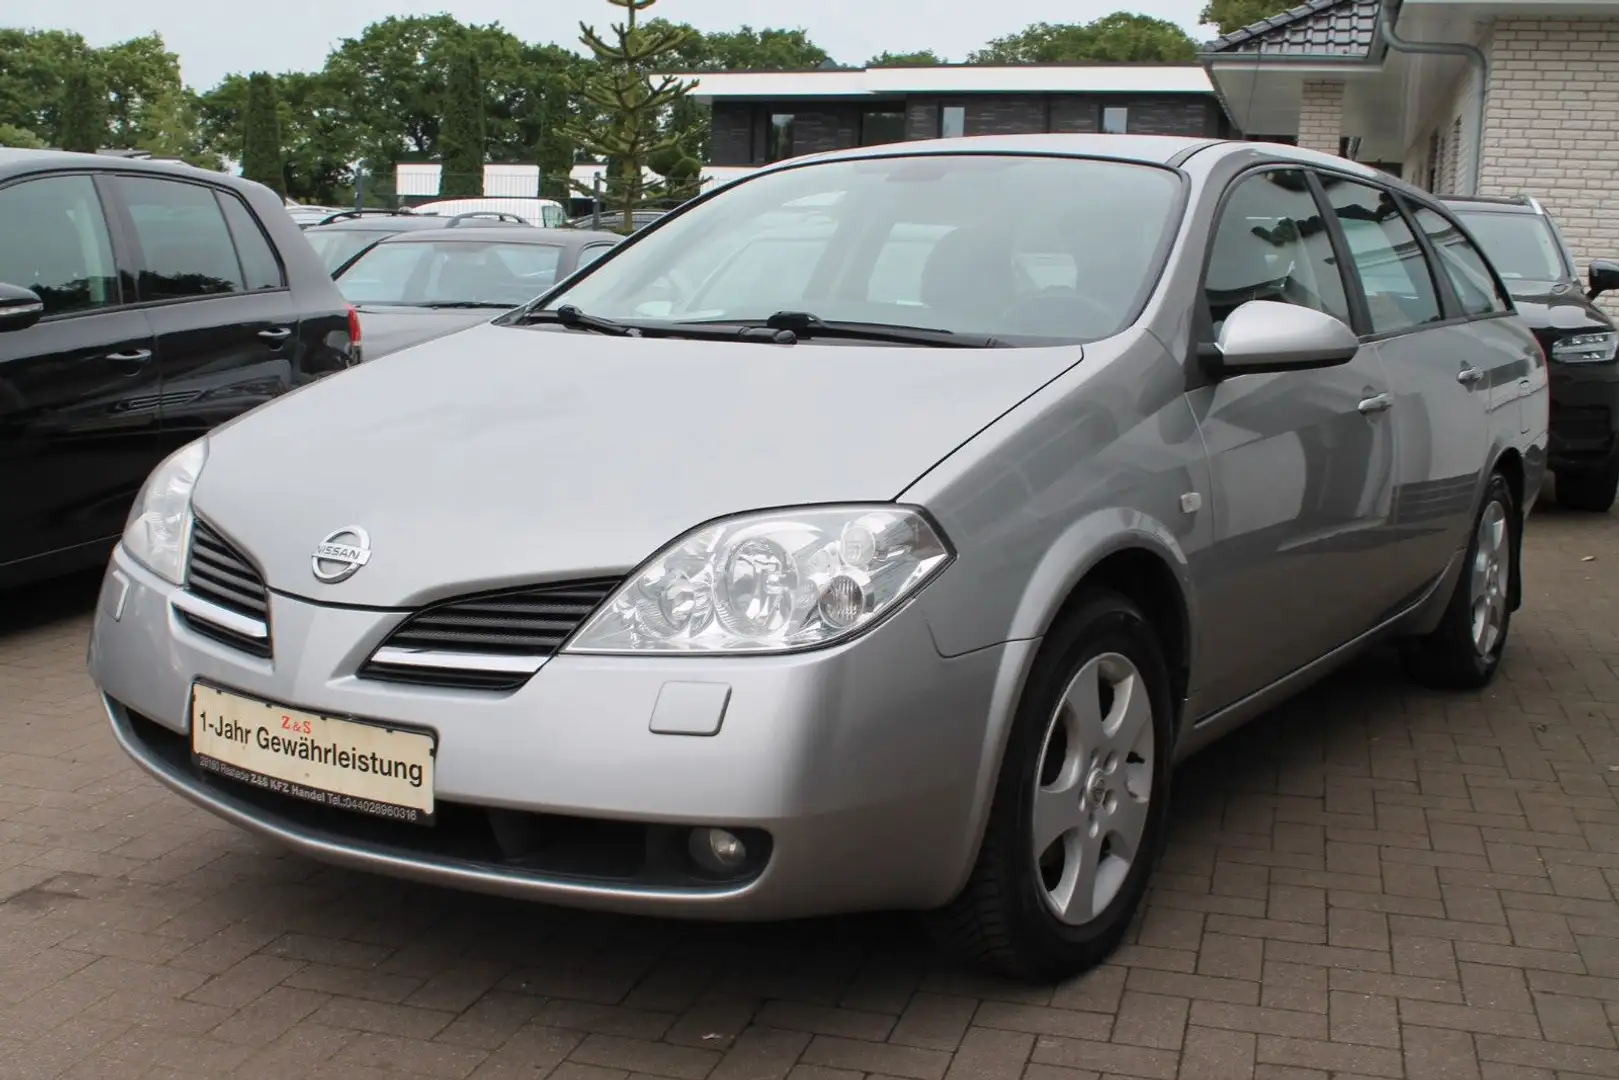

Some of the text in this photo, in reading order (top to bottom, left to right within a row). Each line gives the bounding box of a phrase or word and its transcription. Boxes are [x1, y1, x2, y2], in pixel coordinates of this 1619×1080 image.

[318, 545, 361, 560] NISSAN
[200, 711, 423, 788] 1-Jahr Gewährleistung
[270, 779, 290, 794] KFZ
[291, 784, 326, 803] Handel
